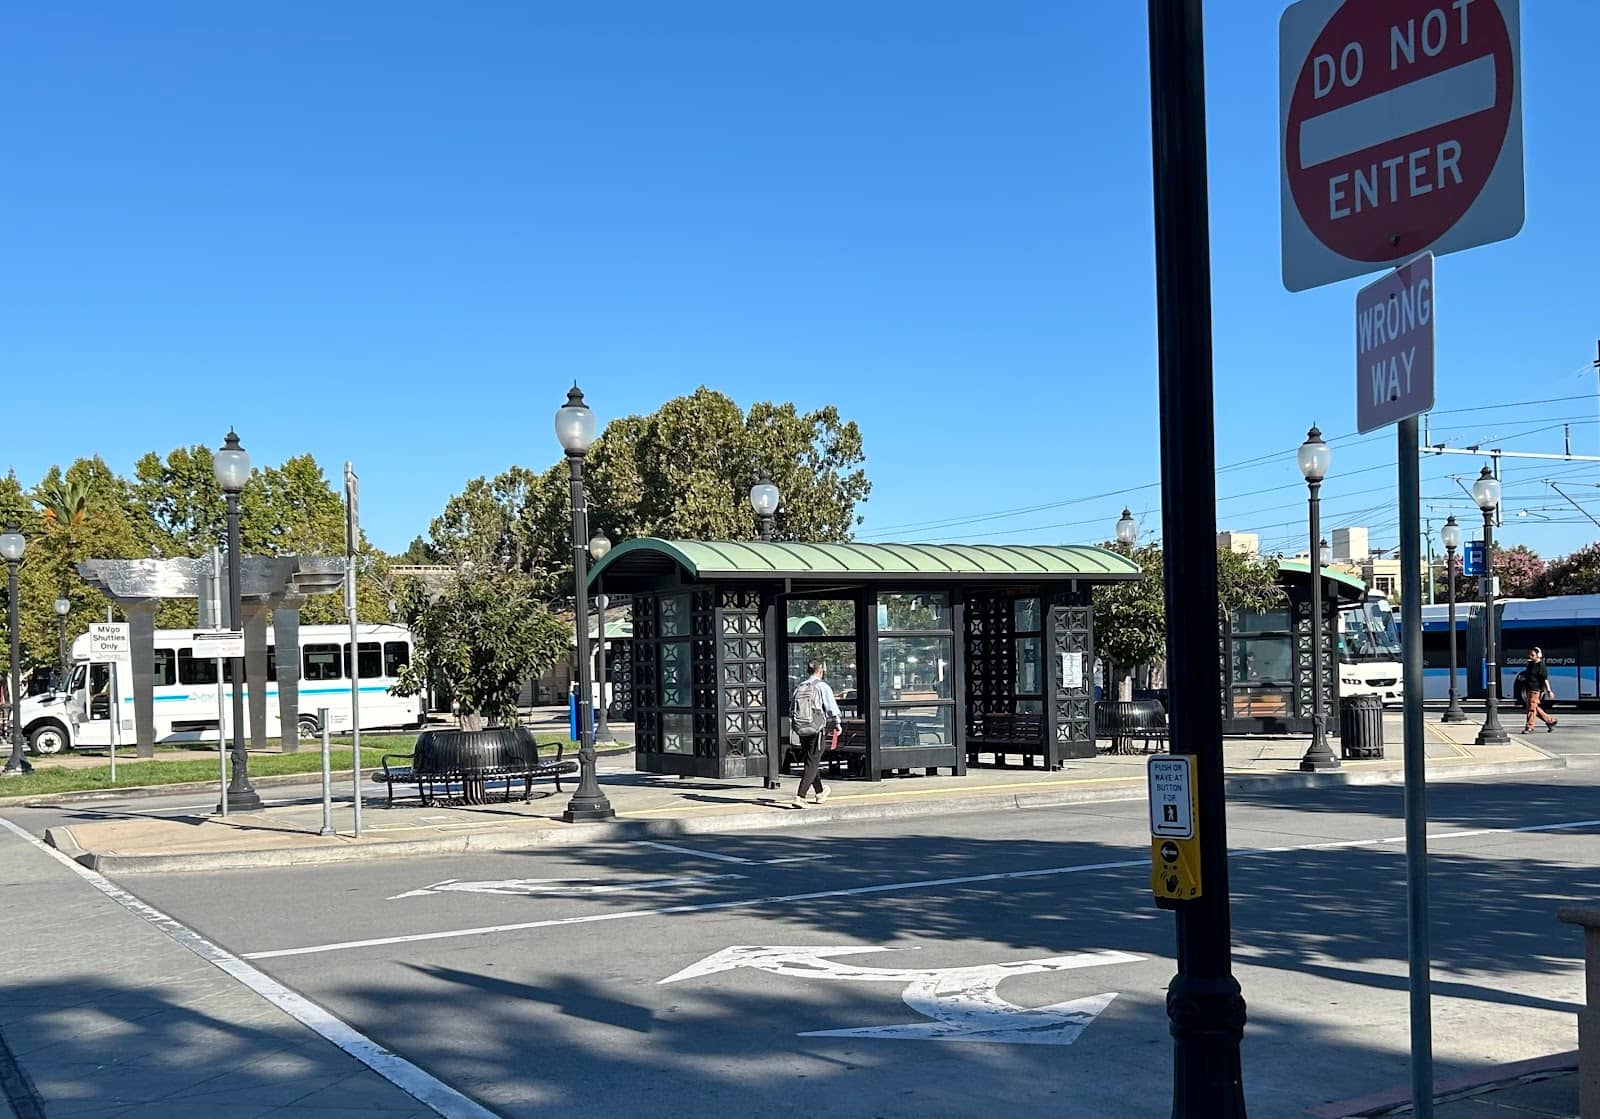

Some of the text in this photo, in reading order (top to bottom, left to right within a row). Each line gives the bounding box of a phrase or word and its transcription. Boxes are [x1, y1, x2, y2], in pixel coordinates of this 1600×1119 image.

[1313, 0, 1474, 100] DO NOT
[1328, 140, 1463, 221] ENTER
[1359, 279, 1430, 354] WRONG
[1371, 346, 1416, 406] WAY
[97, 626, 121, 634] MVgo
[100, 642, 119, 651] Only
[1506, 657, 1530, 665] Solutio
[1546, 657, 1563, 665] move
[1563, 657, 1576, 665] you
[1155, 774, 1173, 782] WAVE
[1156, 783, 1182, 791] BUTTON
[1163, 794, 1177, 802] FOR
